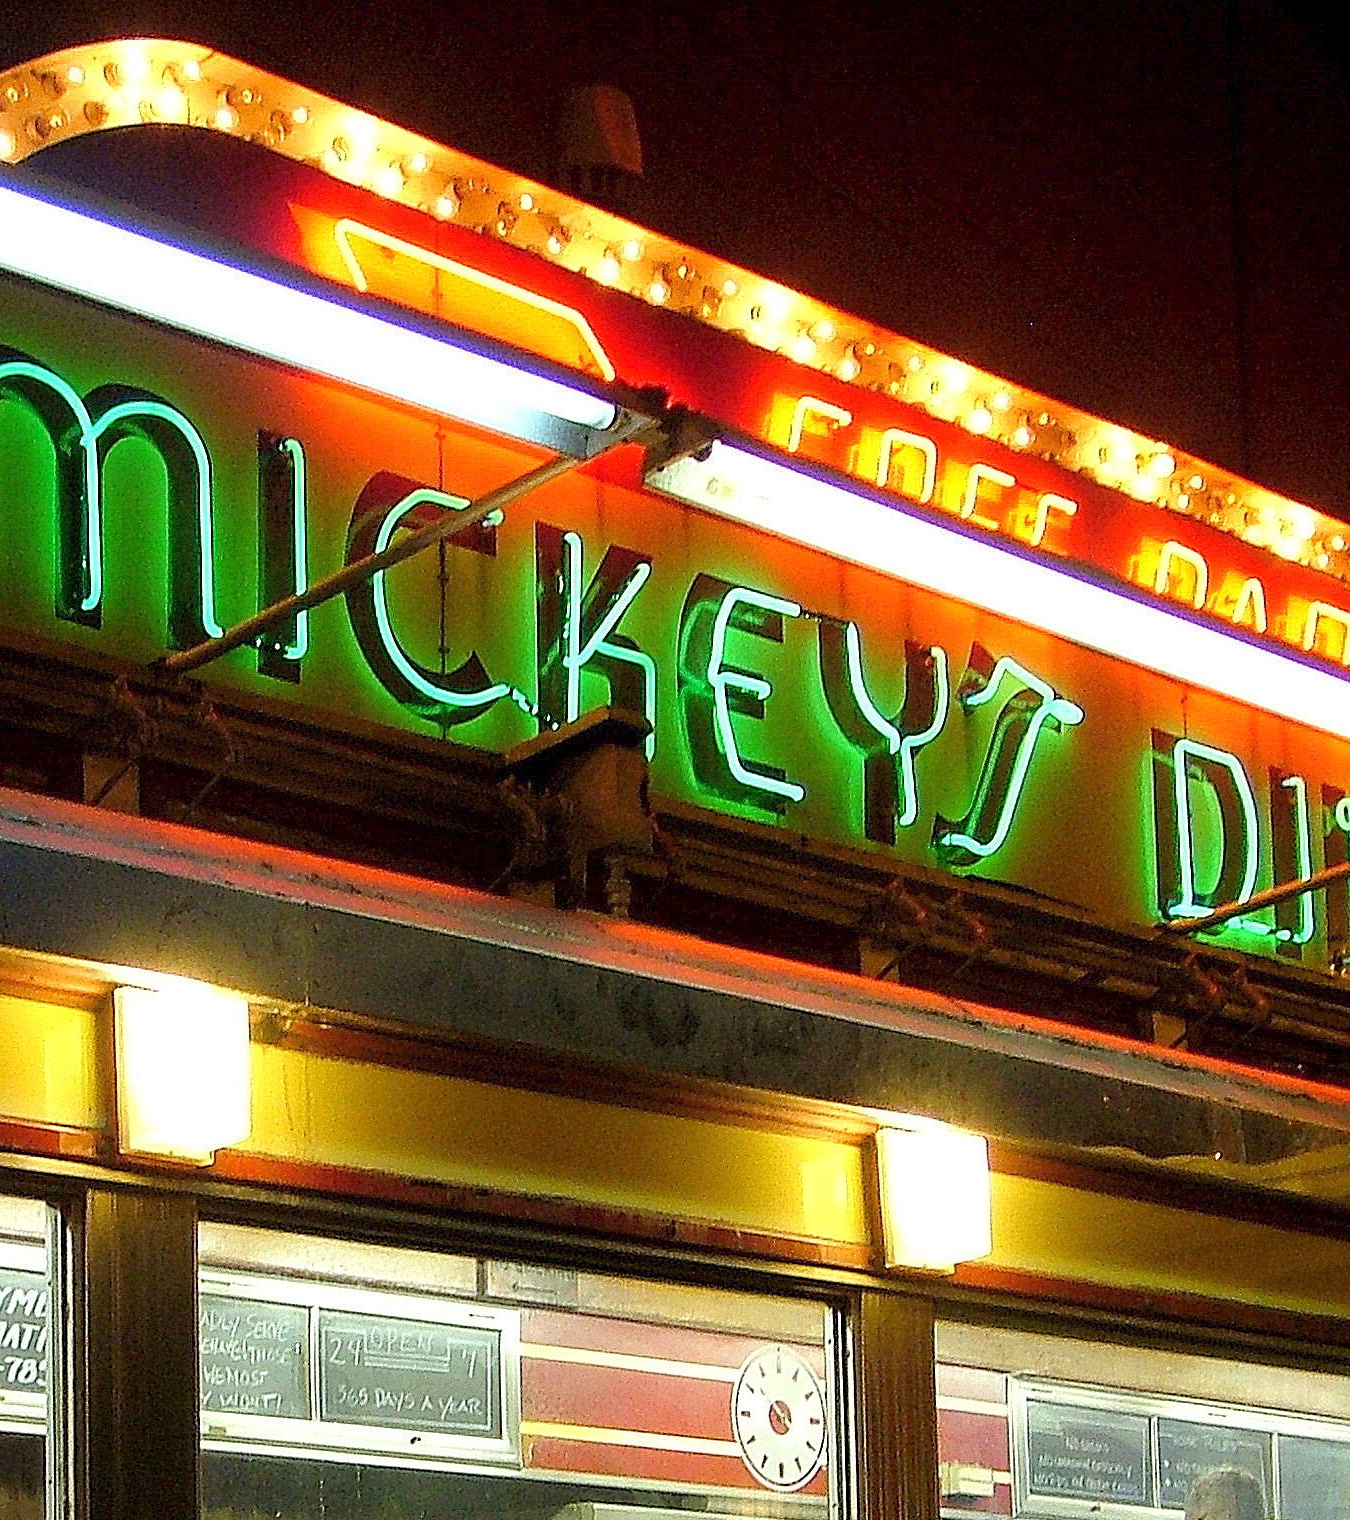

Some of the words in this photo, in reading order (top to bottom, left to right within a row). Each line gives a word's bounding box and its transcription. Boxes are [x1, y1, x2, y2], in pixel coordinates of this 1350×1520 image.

[329, 1337, 362, 1367] 24
[370, 1326, 433, 1354] OPEN
[337, 1383, 369, 1407] 365
[374, 1386, 416, 1412] DAYS
[420, 1394, 433, 1412] A
[438, 1395, 483, 1421] YEAR
